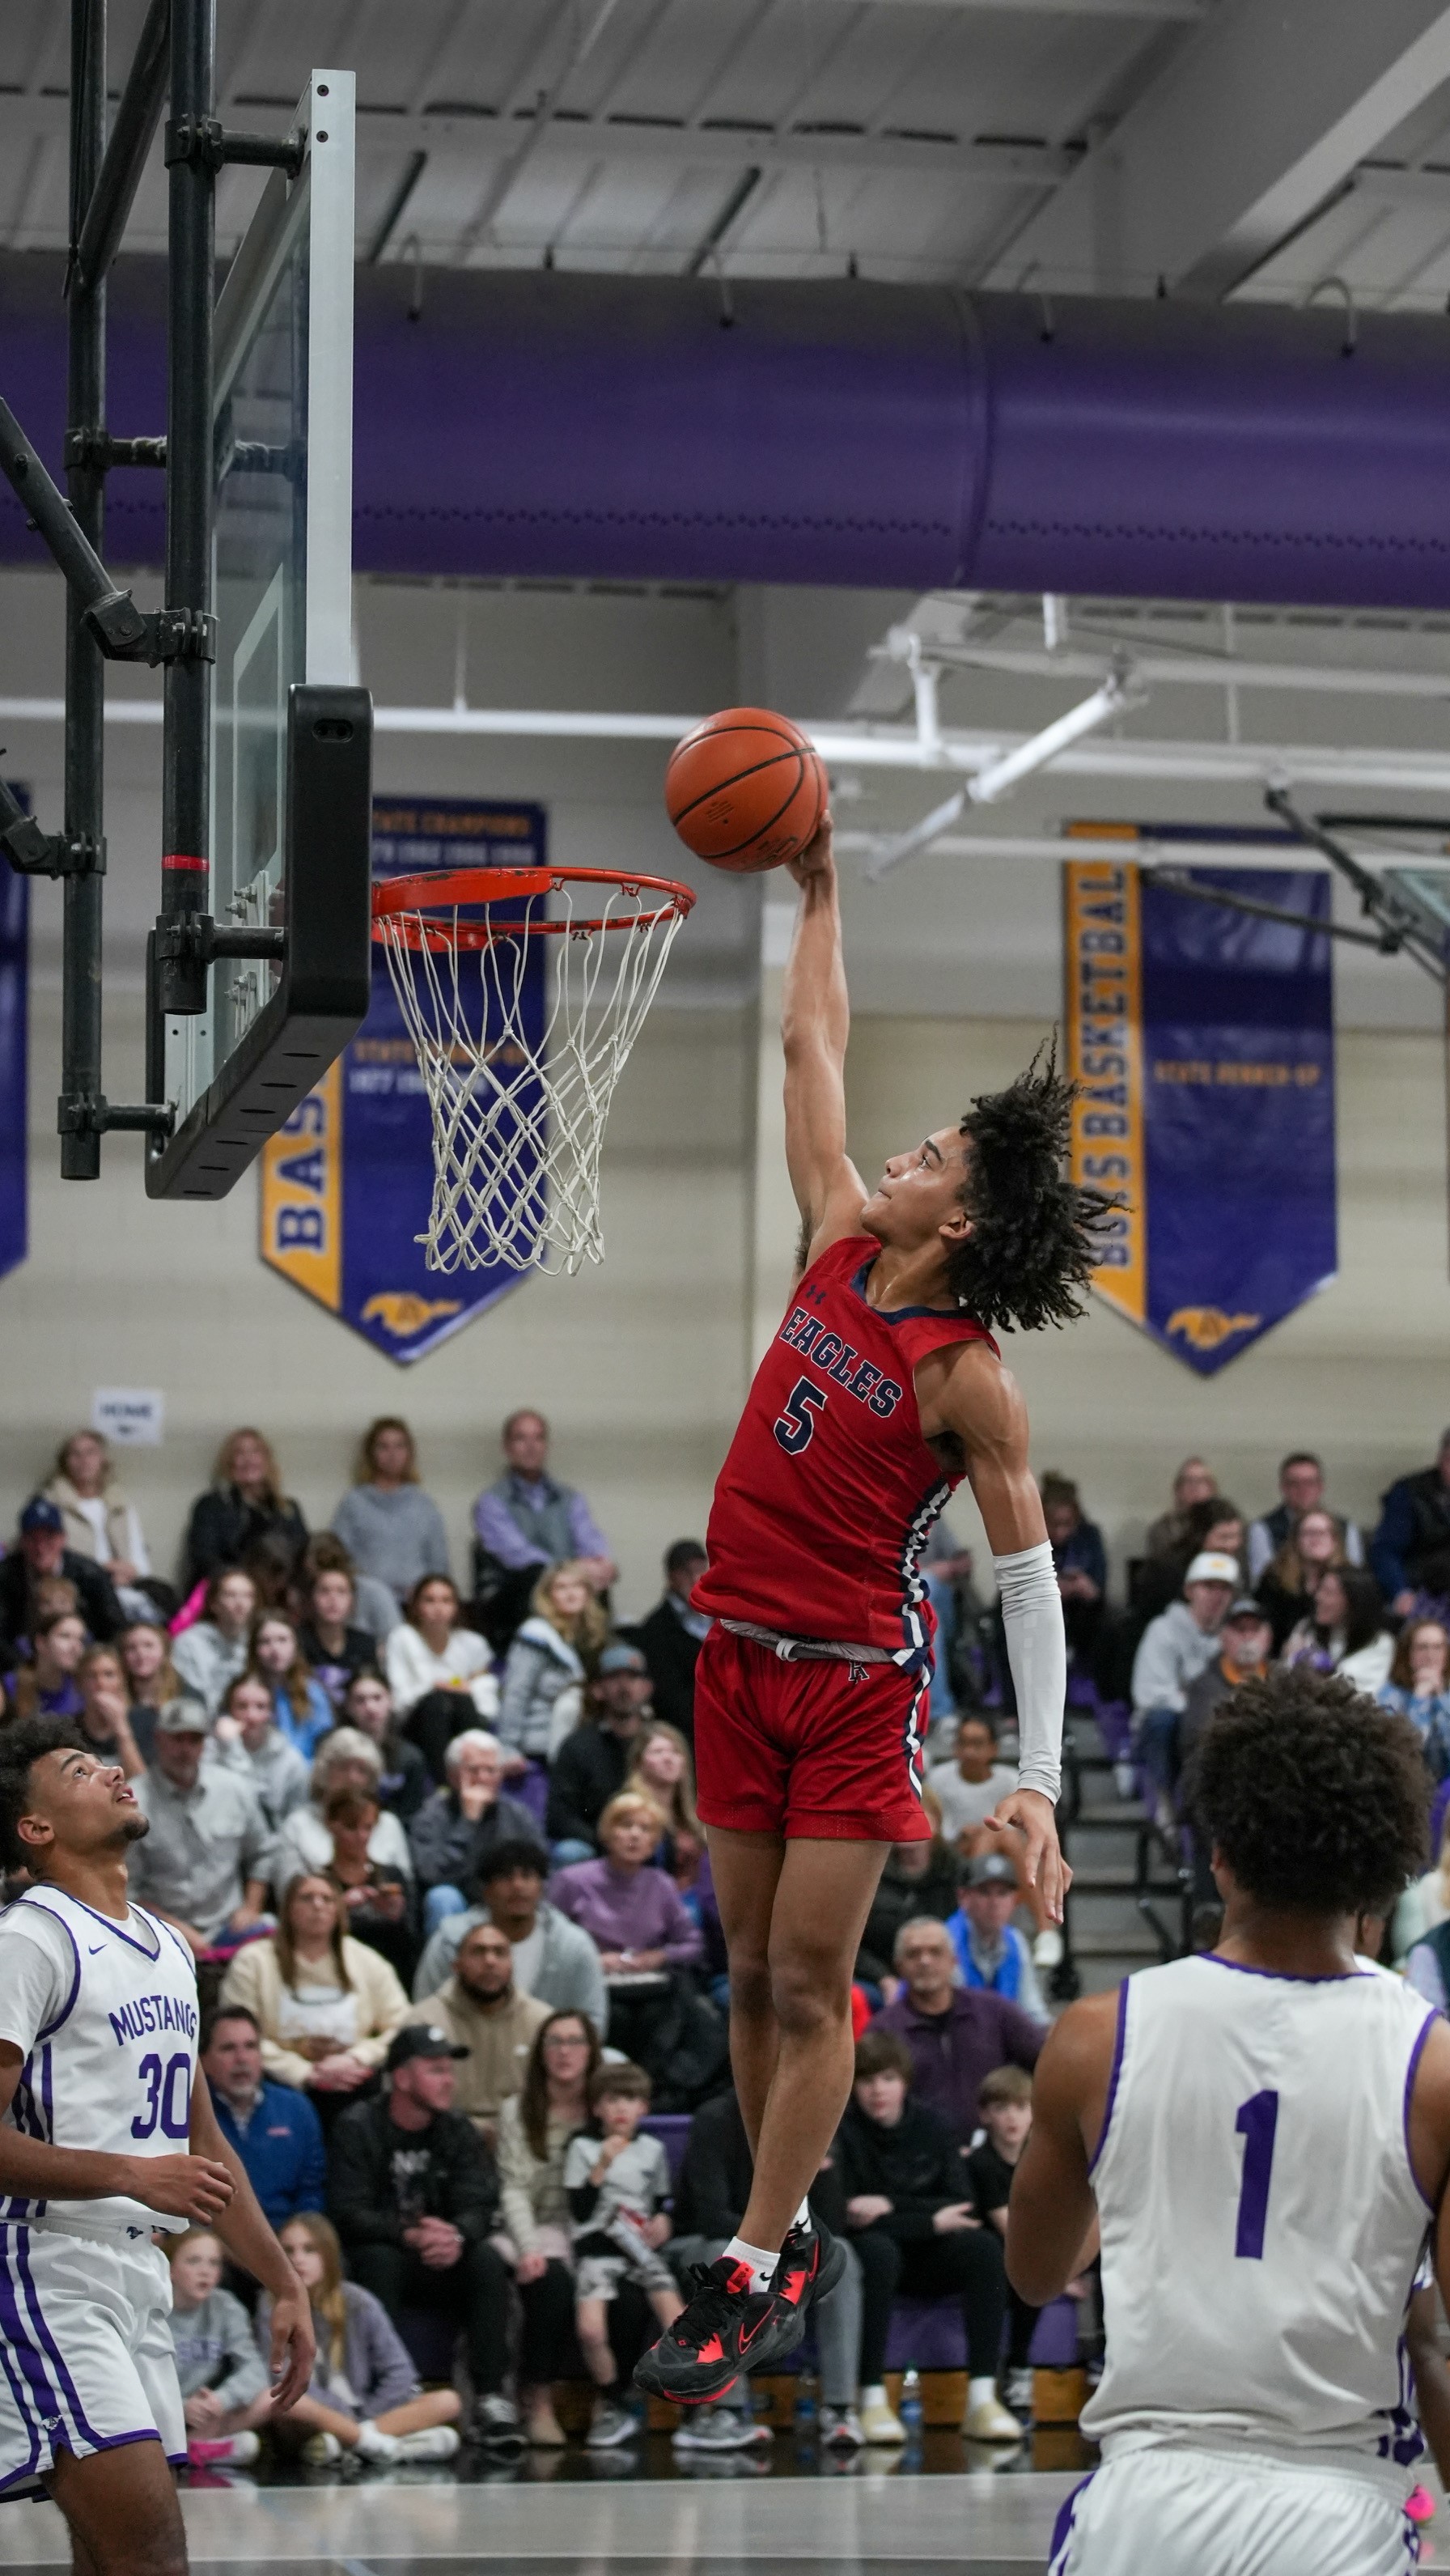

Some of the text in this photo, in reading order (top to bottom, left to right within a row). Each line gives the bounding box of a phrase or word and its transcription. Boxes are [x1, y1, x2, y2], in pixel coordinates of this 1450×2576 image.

[1078, 864, 1130, 1141] BASKETBAL
[273, 1093, 327, 1256] BAS
[774, 1375, 829, 1456] 5
[779, 1306, 903, 1418] EAGLES
[130, 2052, 191, 2139] 30
[1234, 2089, 1278, 2260] 1
